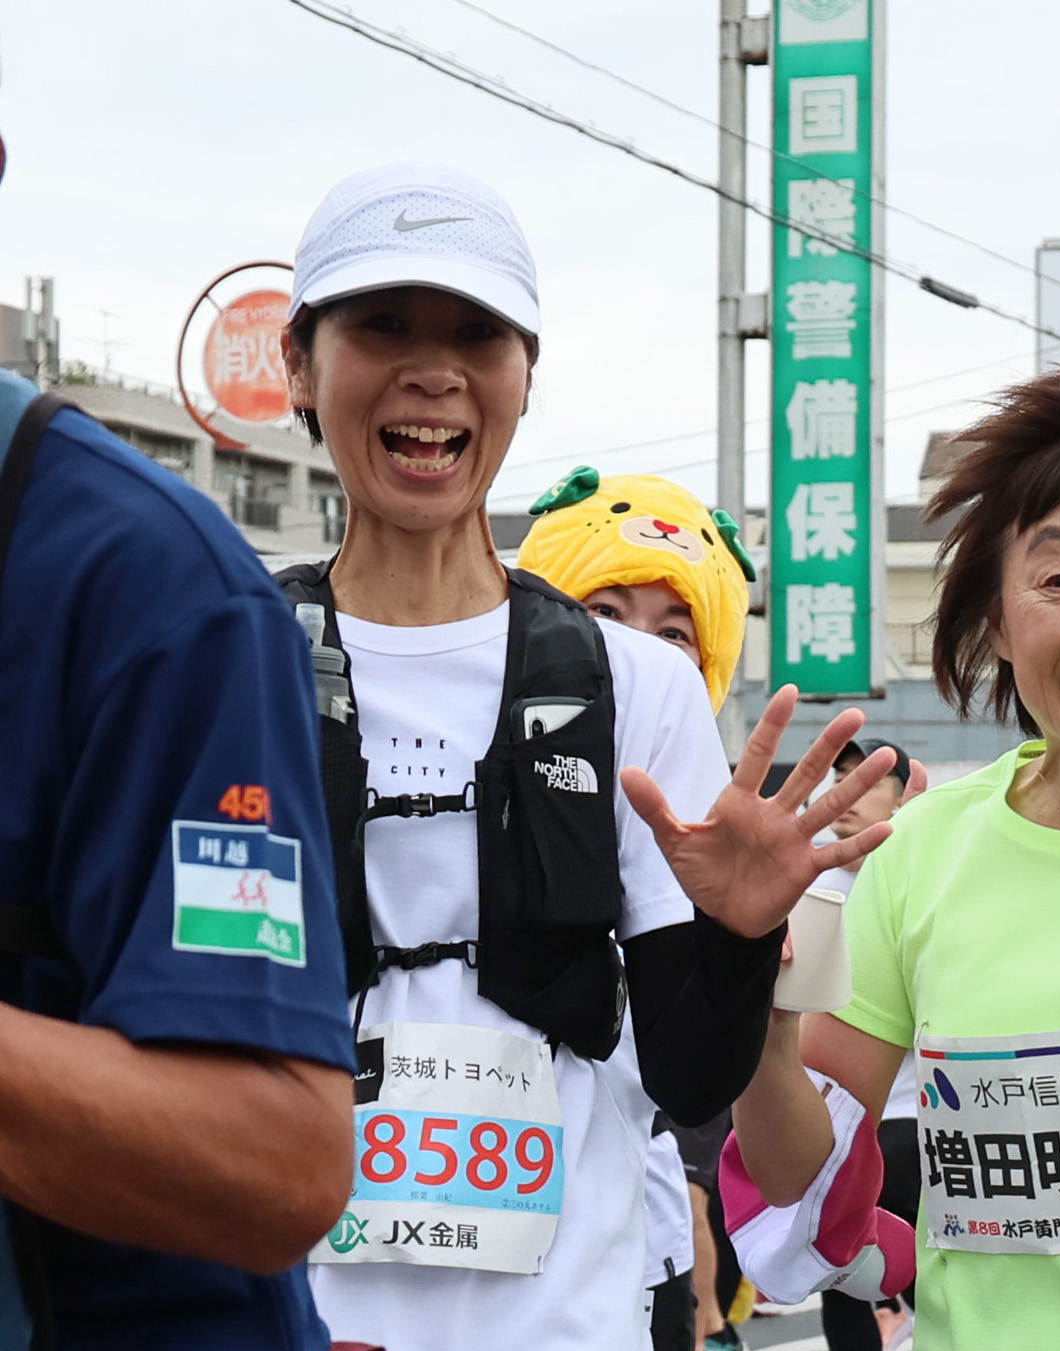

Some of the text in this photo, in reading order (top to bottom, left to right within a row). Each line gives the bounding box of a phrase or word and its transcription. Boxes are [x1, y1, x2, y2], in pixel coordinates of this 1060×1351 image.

[213, 331, 283, 385] 消火
[786, 74, 859, 665] 国際警備保障
[391, 737, 445, 749] THE
[391, 765, 445, 778] CITY
[534, 760, 577, 781] NORTH
[552, 754, 577, 769] THE
[547, 777, 577, 792] FACE
[391, 1055, 532, 1093] 茨城トヨペット
[360, 1113, 555, 1195] 8589
[382, 1219, 479, 1250] JX金属
